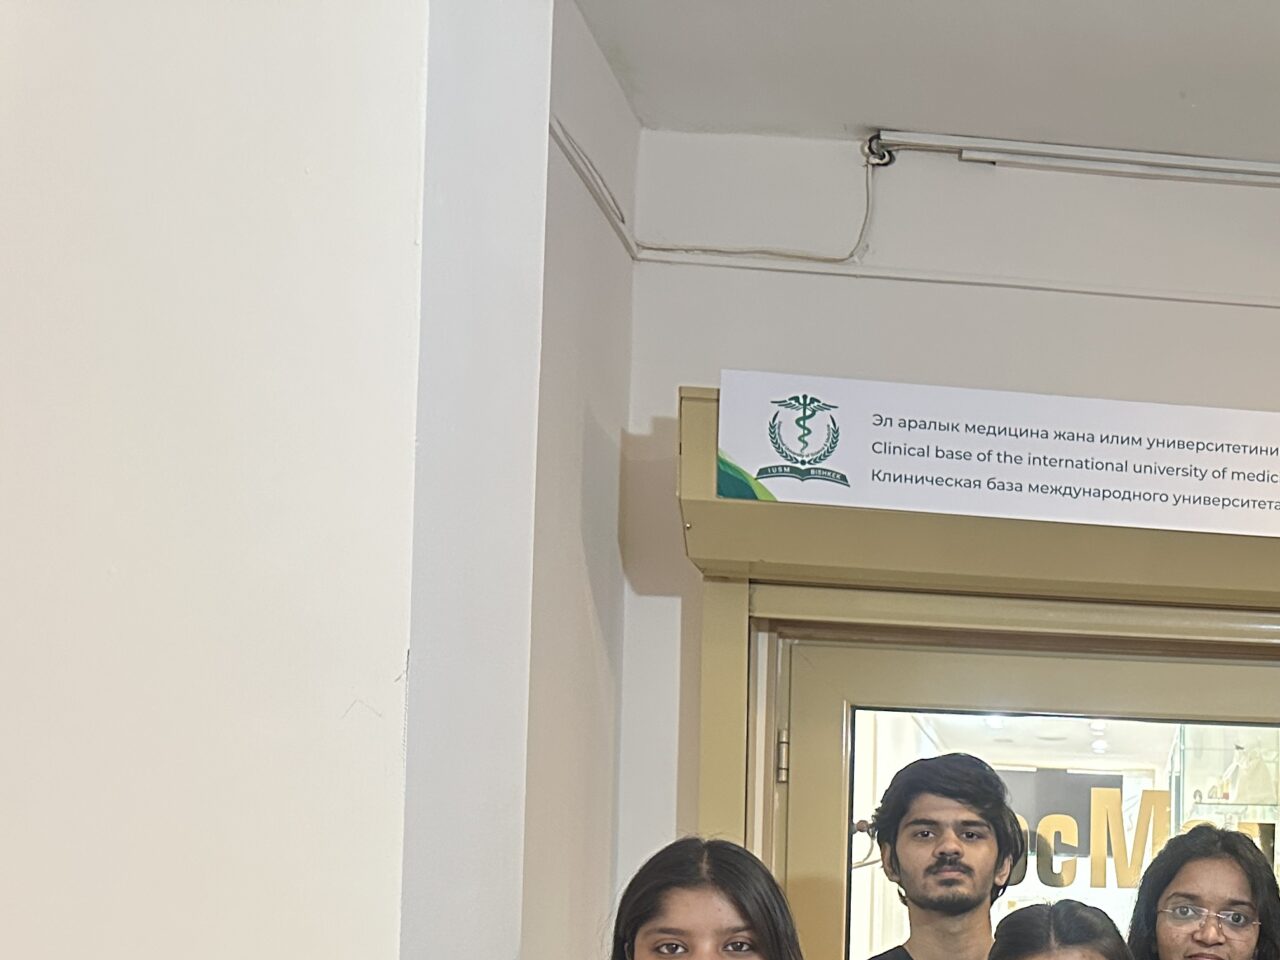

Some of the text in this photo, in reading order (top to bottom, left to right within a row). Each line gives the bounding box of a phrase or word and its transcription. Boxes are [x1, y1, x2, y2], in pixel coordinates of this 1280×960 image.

[871, 413, 893, 428] Эл
[897, 417, 960, 433] аралык
[964, 423, 1049, 440] медицина
[1053, 429, 1095, 443] жана
[1099, 433, 1142, 446] илим
[767, 466, 791, 474] IUSM
[871, 441, 930, 458] Clinical
[935, 445, 973, 461] base
[976, 449, 993, 463] of
[996, 450, 1023, 465] the
[1027, 452, 1128, 473] international
[1133, 461, 1208, 481] university
[1211, 467, 1228, 480] of
[871, 468, 981, 489] Клиническая
[986, 477, 1023, 492] база
[1028, 482, 1169, 502] международного
